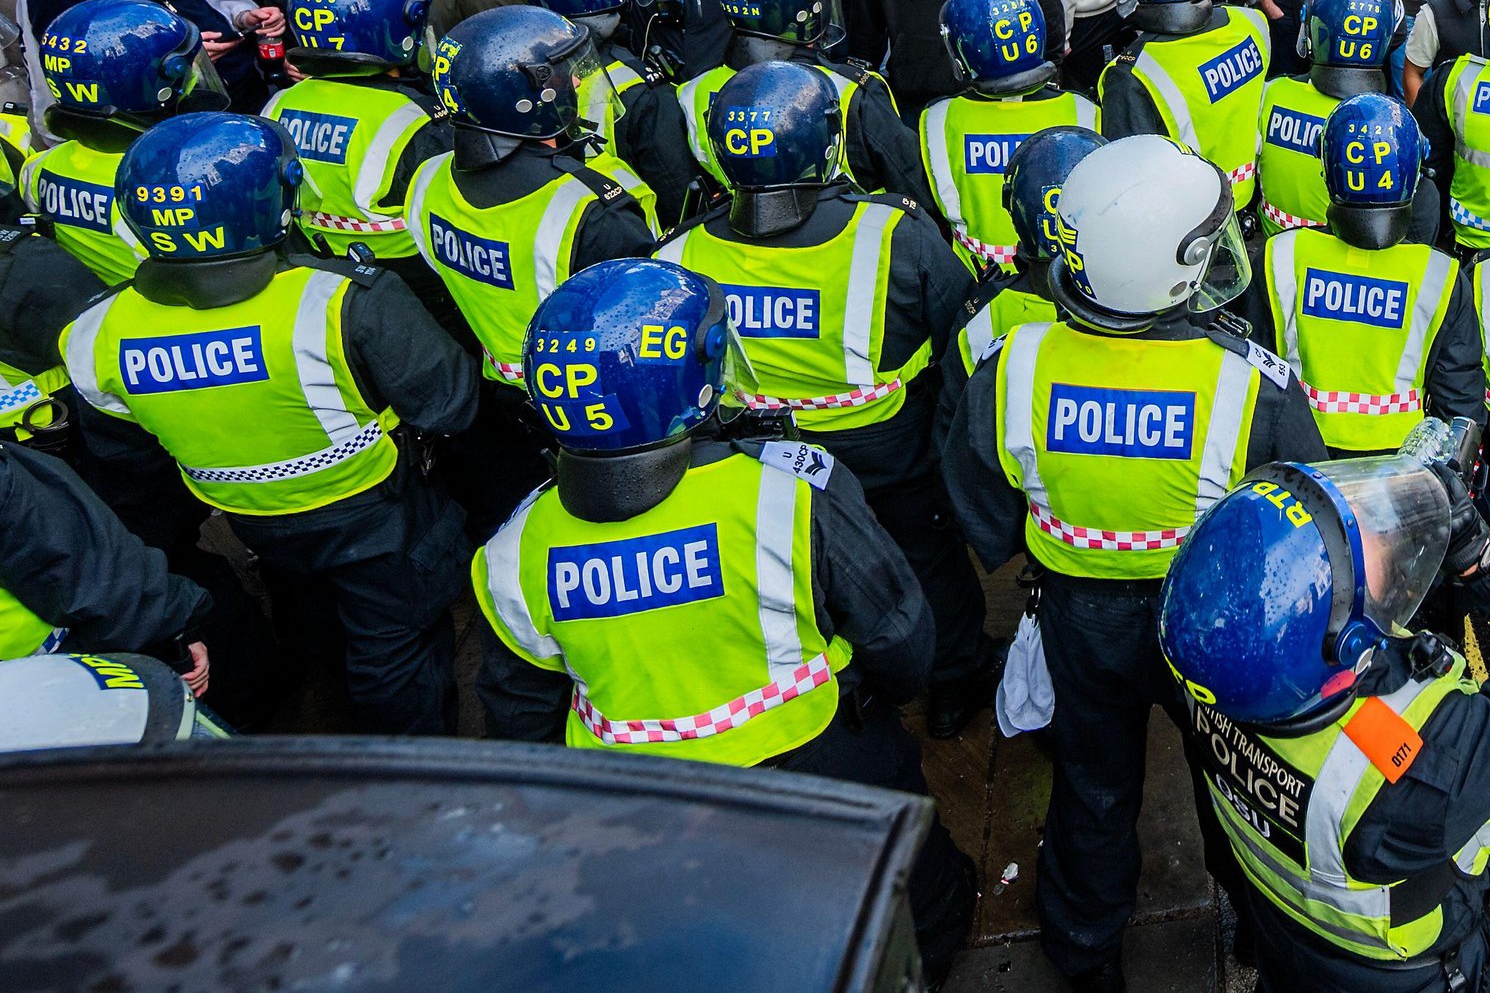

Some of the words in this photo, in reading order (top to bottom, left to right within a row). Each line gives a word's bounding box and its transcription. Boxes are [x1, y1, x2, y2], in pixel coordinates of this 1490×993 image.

[295, 8, 335, 31] CP
[1351, 2, 1379, 13] 2778
[995, 11, 1033, 40] CP
[1344, 16, 1377, 35] CP
[42, 33, 87, 54] 5432
[44, 54, 71, 73] MP
[1204, 43, 1263, 95] POLICE
[728, 111, 771, 122] 3377
[1269, 111, 1325, 152] POLIC
[1349, 124, 1394, 135] 3421
[280, 117, 348, 155] POLICE
[725, 128, 774, 155] CP
[1346, 141, 1390, 164] CP
[38, 178, 107, 225] POLICE
[136, 186, 202, 203] 9391
[1044, 188, 1062, 214] C
[152, 208, 195, 226] MP
[432, 224, 507, 281] POLICE
[727, 294, 813, 330] OLICE
[1308, 278, 1401, 320] POLICE
[536, 337, 596, 353] 3249
[640, 325, 687, 360] EG
[125, 337, 258, 385] POLICE
[536, 363, 598, 399] CP
[1054, 398, 1186, 447] POLICE
[555, 539, 713, 608] POLICE
[1196, 705, 1300, 828] POLICE
[1234, 727, 1305, 798] TRANSPORT
[1391, 742, 1412, 768] 0171
[1215, 773, 1271, 838] OSU
